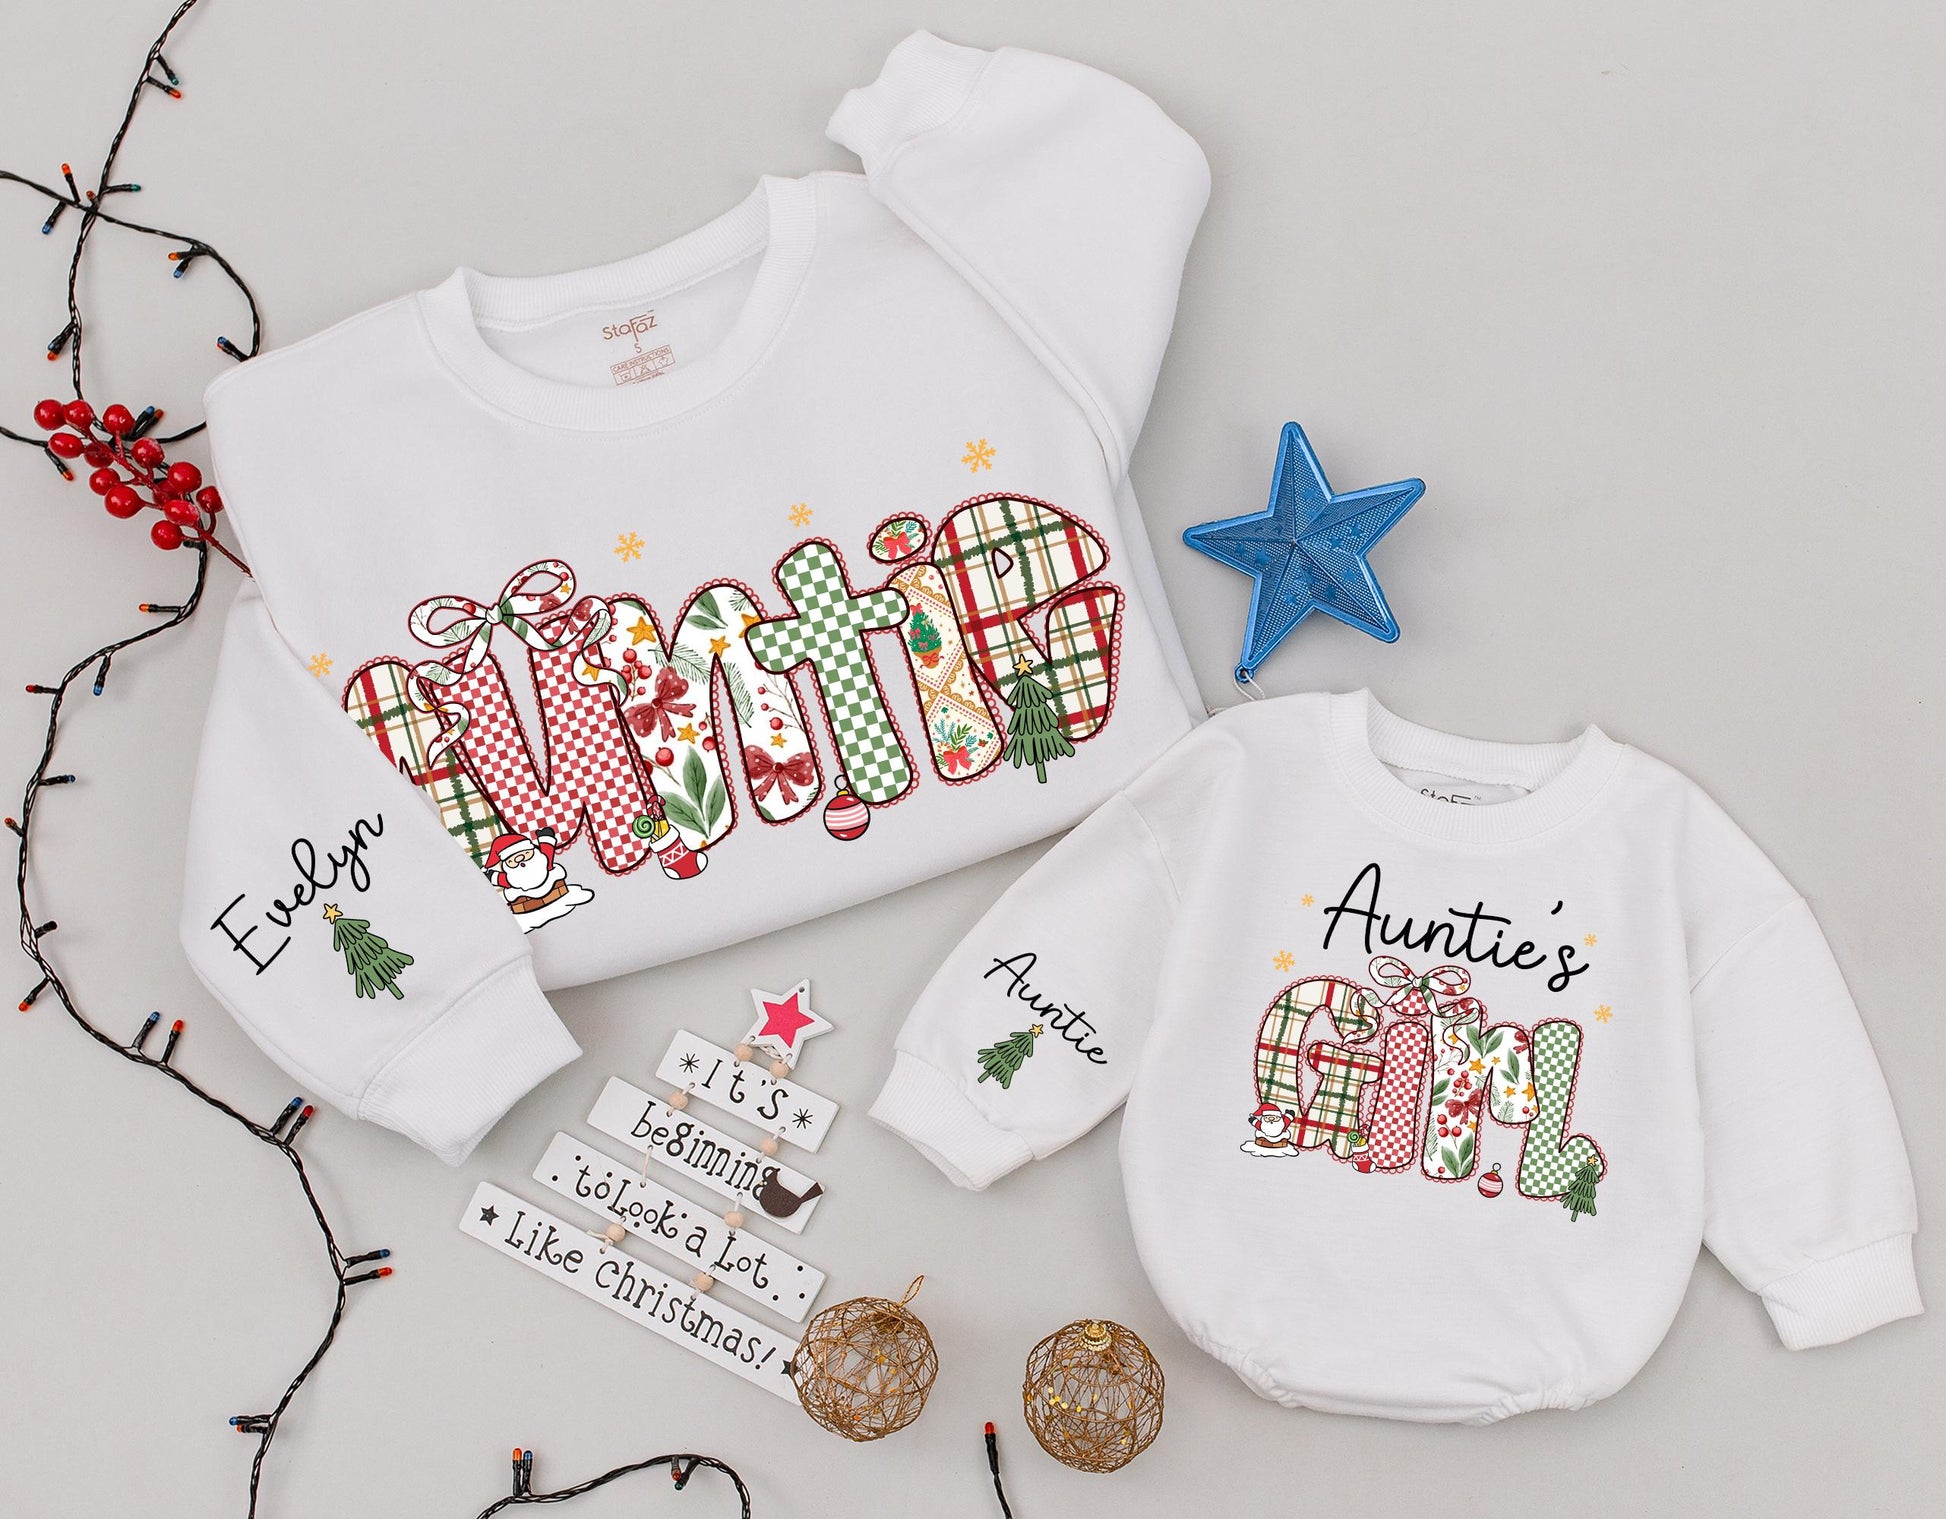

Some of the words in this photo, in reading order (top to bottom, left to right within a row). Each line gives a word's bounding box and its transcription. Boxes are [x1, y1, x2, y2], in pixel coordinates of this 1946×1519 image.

[211, 813, 384, 976] Evelyn
[1323, 862, 1590, 993] Auntie's
[983, 952, 1108, 1064] Auntie
[504, 1210, 584, 1273] Like
[595, 1260, 777, 1370] Christmas!
[685, 1226, 708, 1257] a
